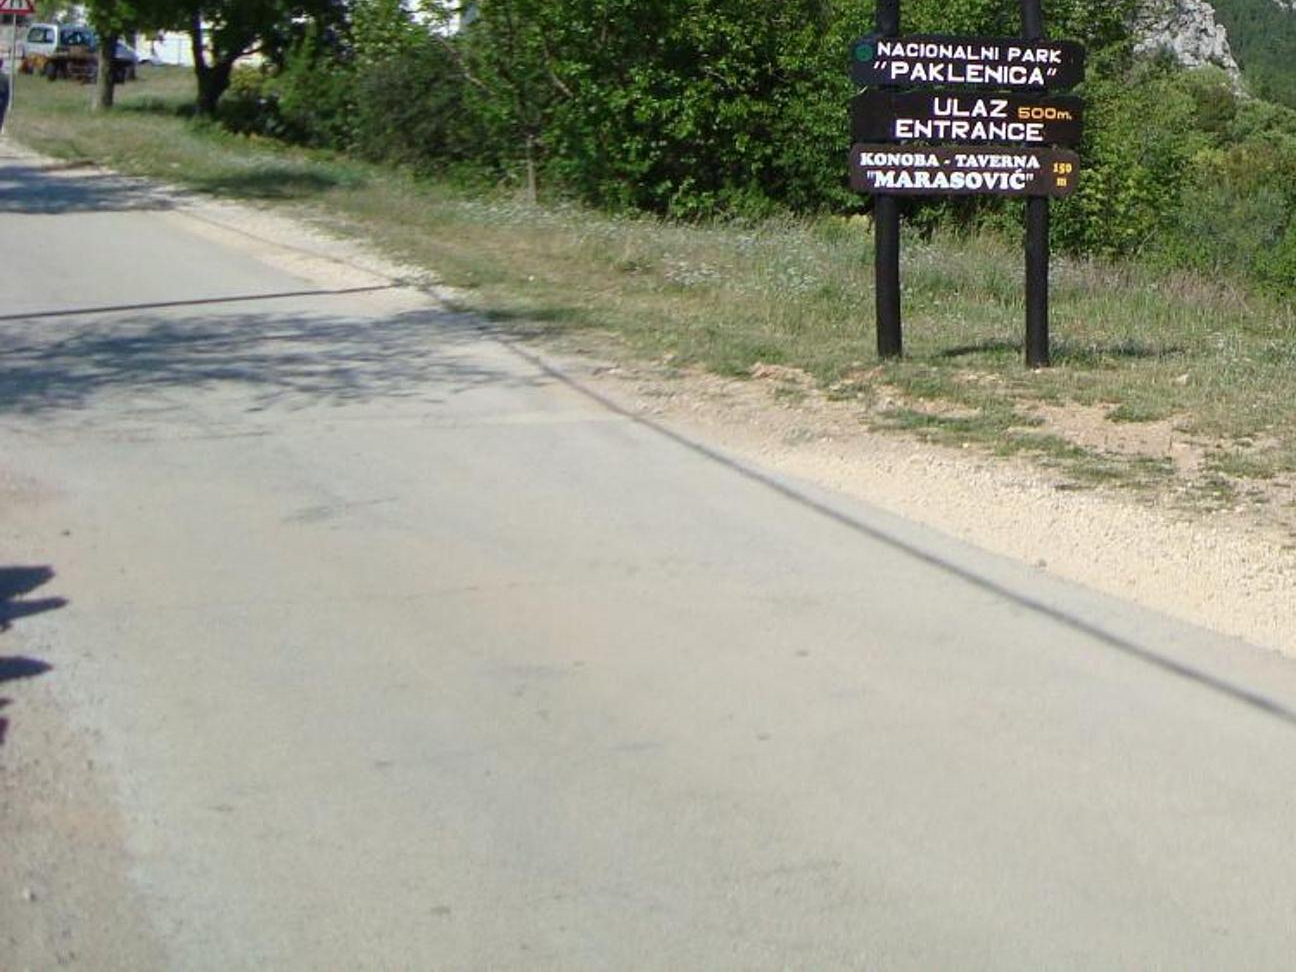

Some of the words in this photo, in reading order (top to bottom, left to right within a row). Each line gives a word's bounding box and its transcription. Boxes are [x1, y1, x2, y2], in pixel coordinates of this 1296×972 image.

[877, 41, 999, 61] NACIONALNI
[1007, 47, 1061, 64] PARK
[933, 97, 1009, 118] ULAZ
[895, 119, 1044, 142] ENTRANCE
[860, 152, 941, 167] KONOBA
[955, 155, 1040, 169] TAVERNA
[1053, 162, 1072, 173] 150
[1056, 177, 1067, 187] m
